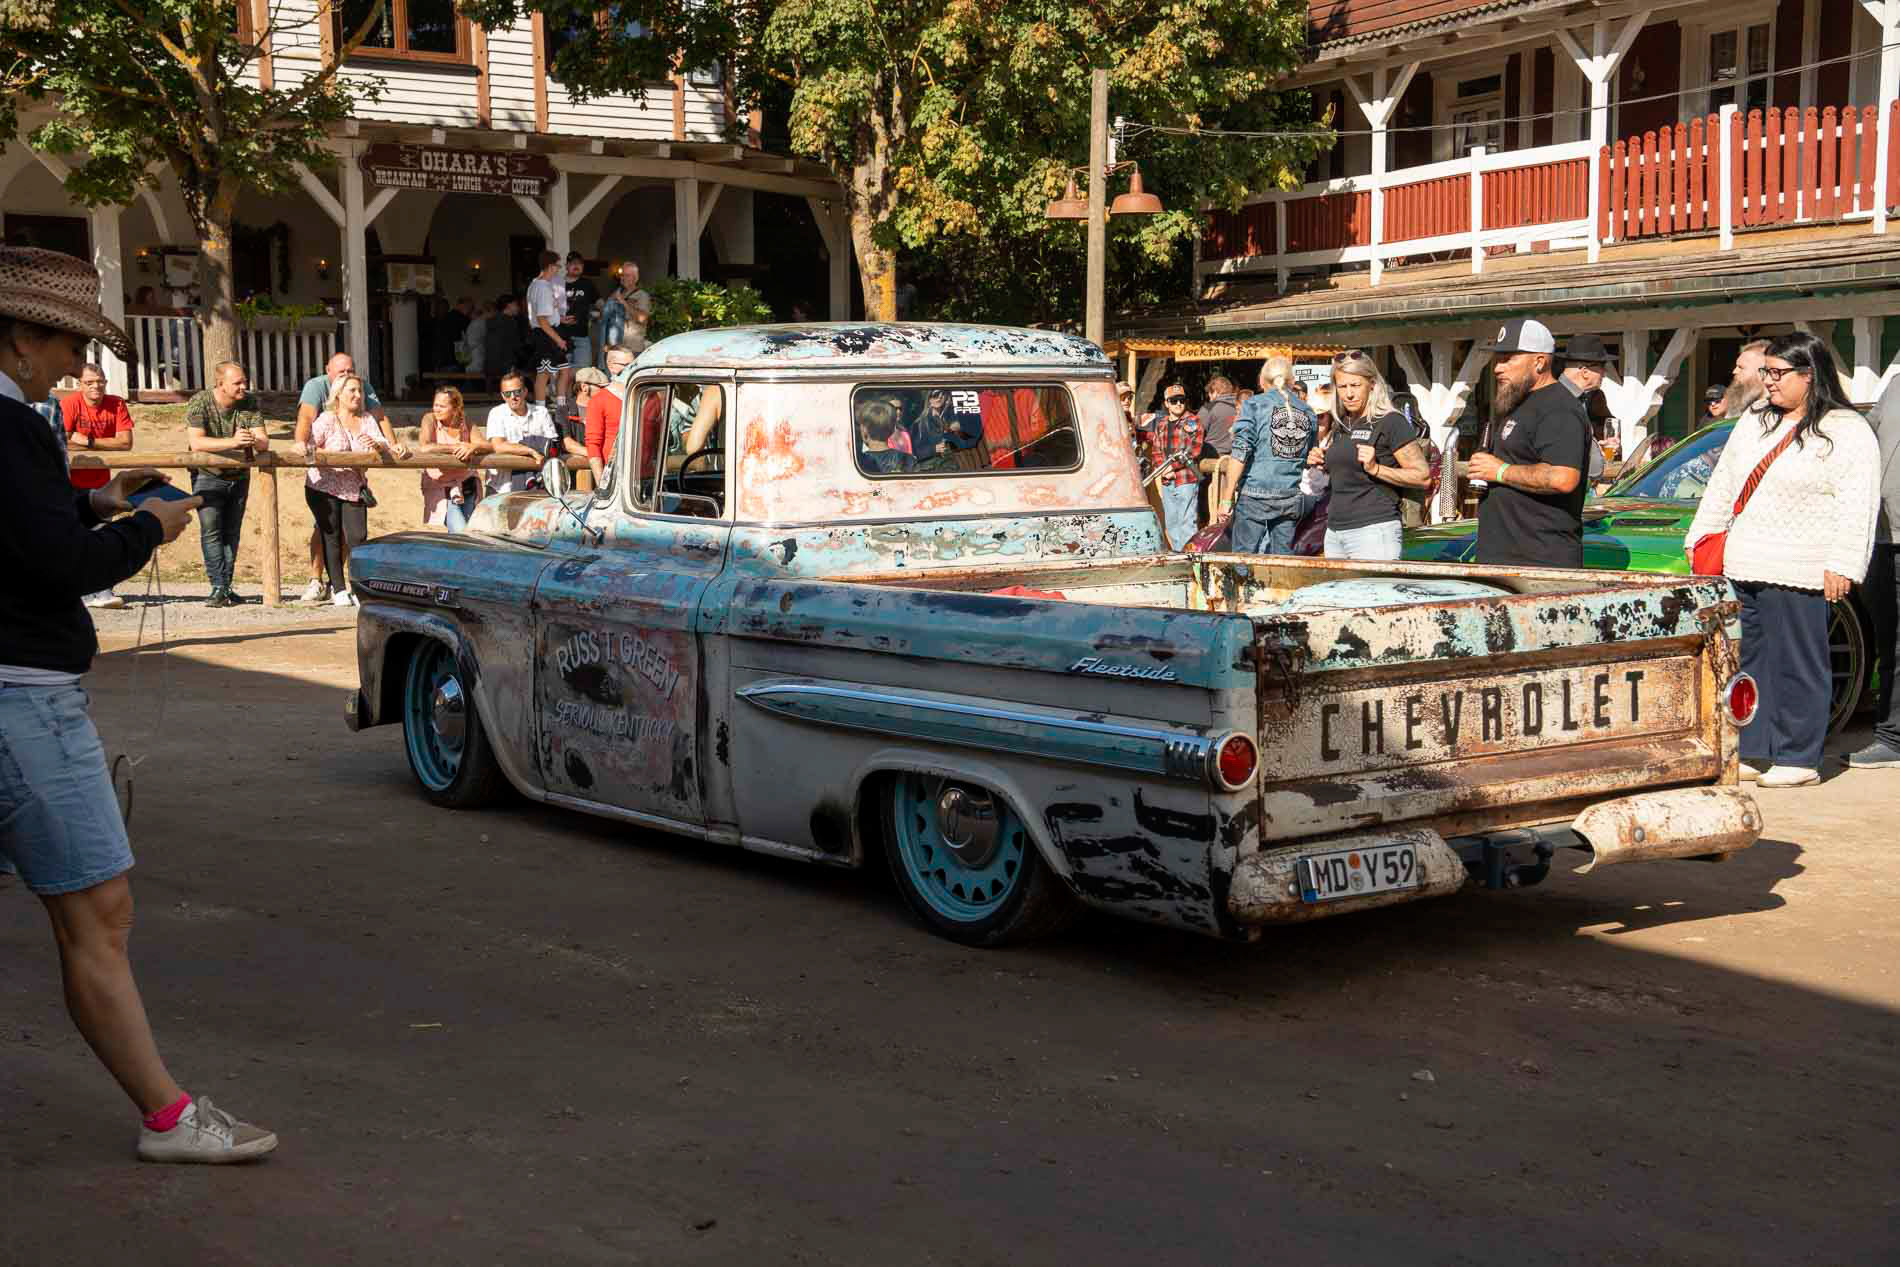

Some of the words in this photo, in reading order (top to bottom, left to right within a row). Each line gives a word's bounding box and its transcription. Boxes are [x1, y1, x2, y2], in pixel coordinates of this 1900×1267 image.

[421, 151, 507, 176] OHARA'S
[375, 169, 428, 188] BREAKFAST
[452, 175, 482, 192] LUNCH
[511, 178, 540, 195] COFFEE
[556, 630, 600, 679] RUSS
[619, 632, 680, 701] GREEN
[1071, 656, 1176, 681] Fleetside
[1321, 670, 1644, 762] CHEVROLET
[1314, 858, 1349, 895] MD
